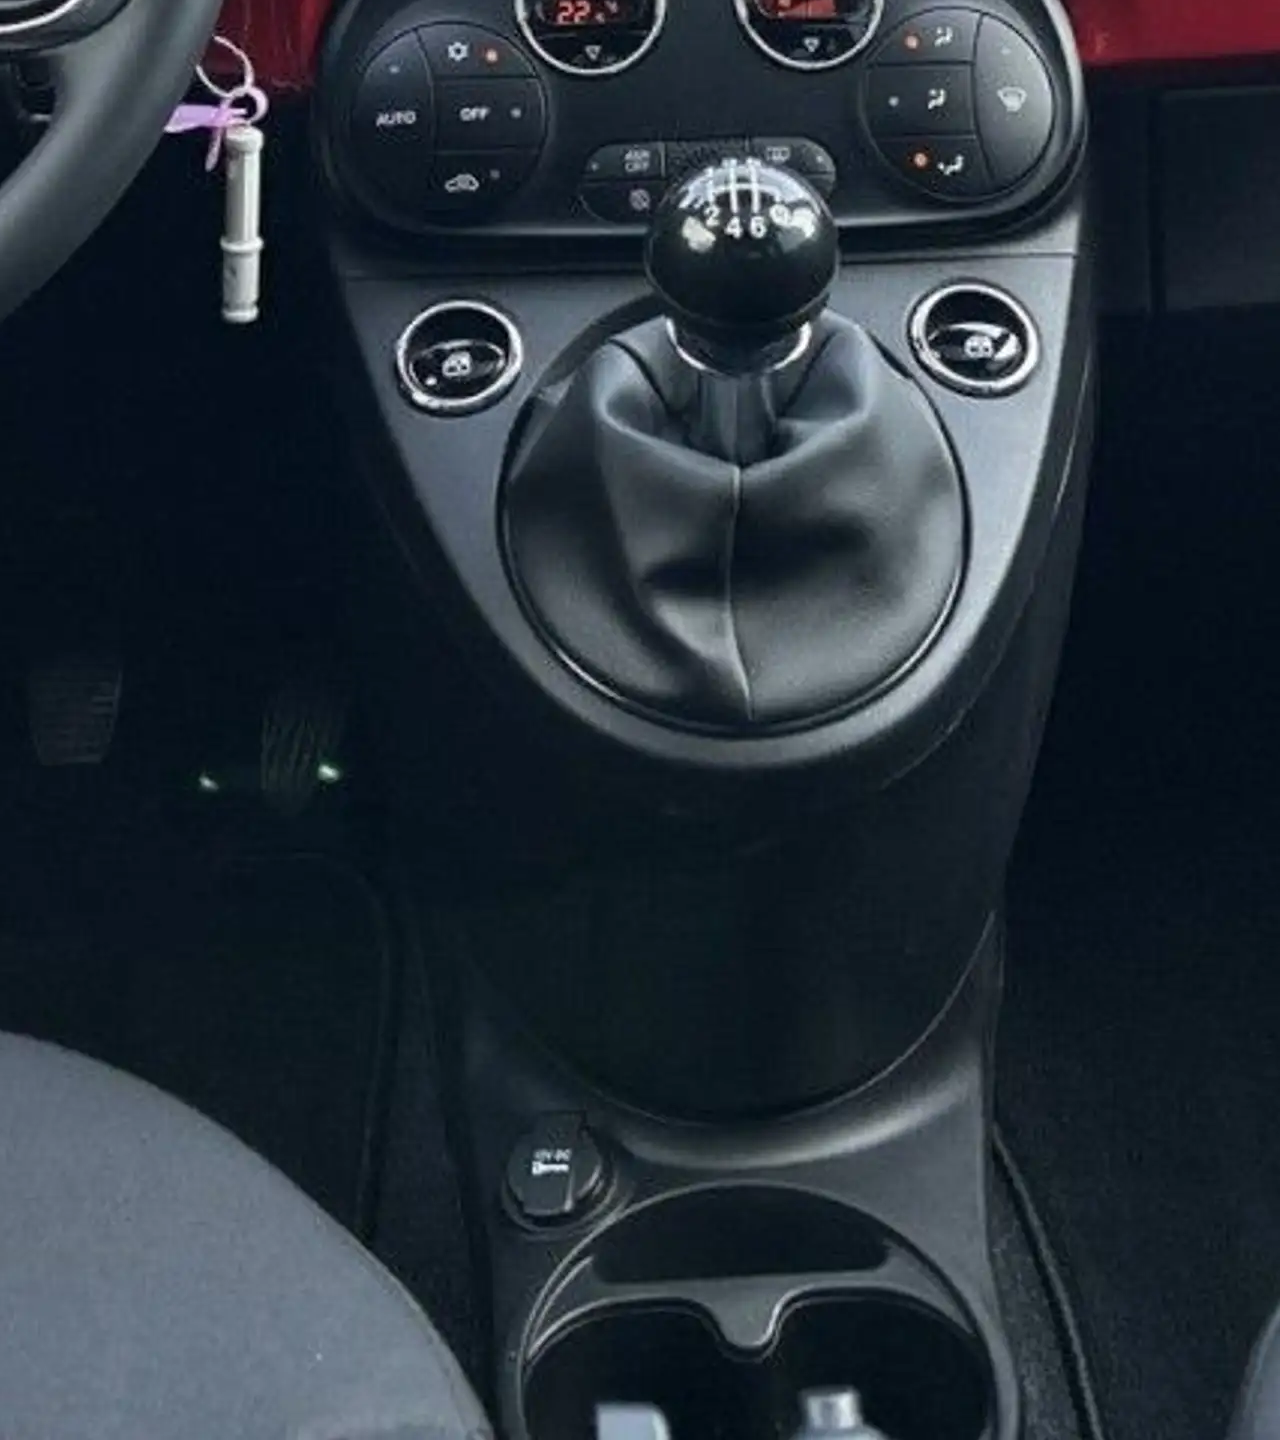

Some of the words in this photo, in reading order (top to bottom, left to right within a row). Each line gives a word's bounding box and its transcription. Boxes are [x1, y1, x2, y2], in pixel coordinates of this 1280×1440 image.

[556, 0, 592, 27] 22
[375, 109, 418, 128] AUTO
[458, 106, 492, 123] OFF
[704, 204, 720, 228] 2
[724, 216, 743, 239] 4
